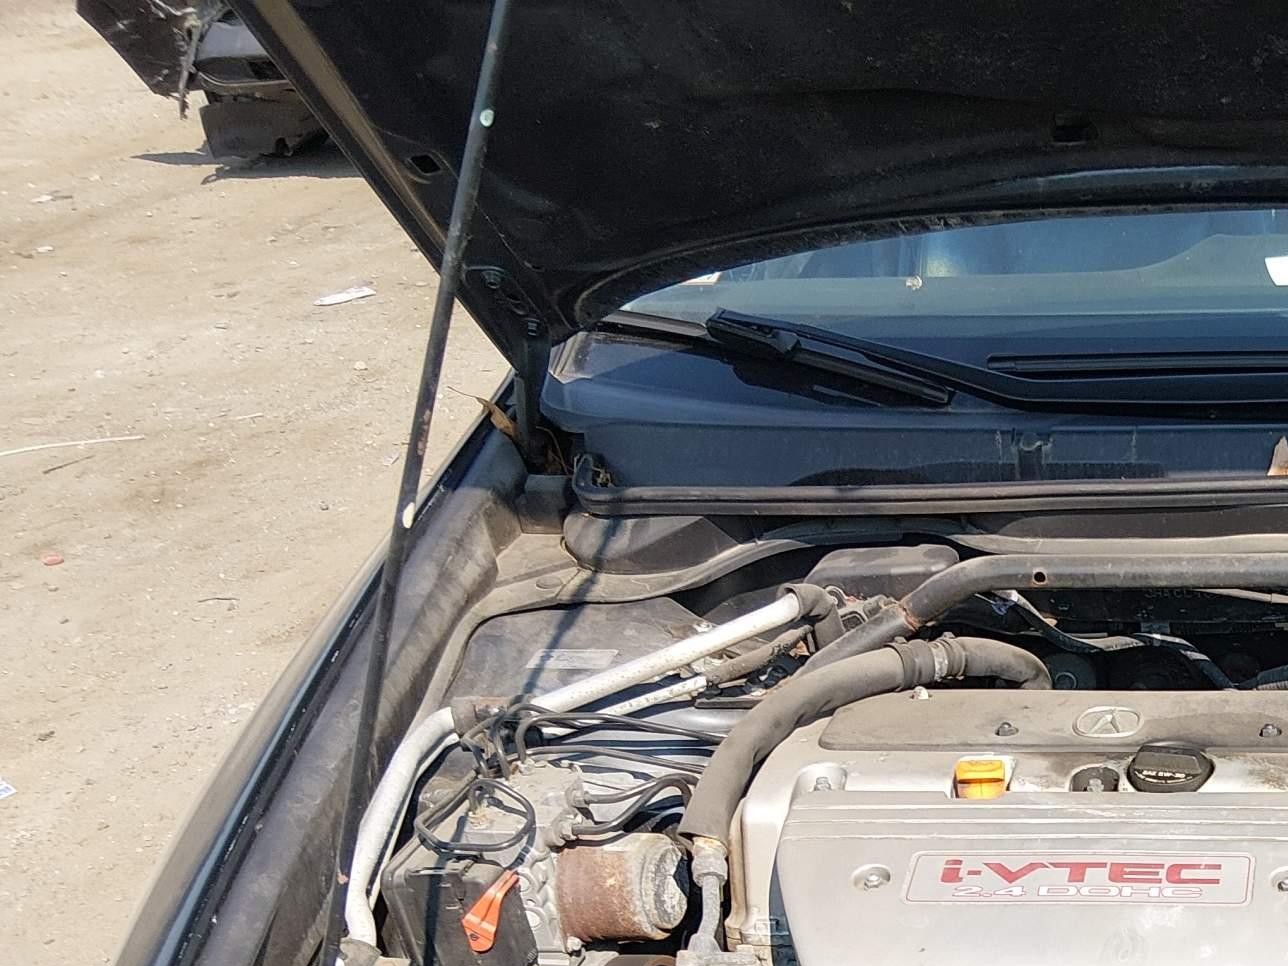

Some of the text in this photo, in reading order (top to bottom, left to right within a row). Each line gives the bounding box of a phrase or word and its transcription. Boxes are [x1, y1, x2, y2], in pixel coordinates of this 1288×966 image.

[940, 859, 1222, 885] i-VTEC
[951, 885, 1203, 898] 2.4 DOHC
